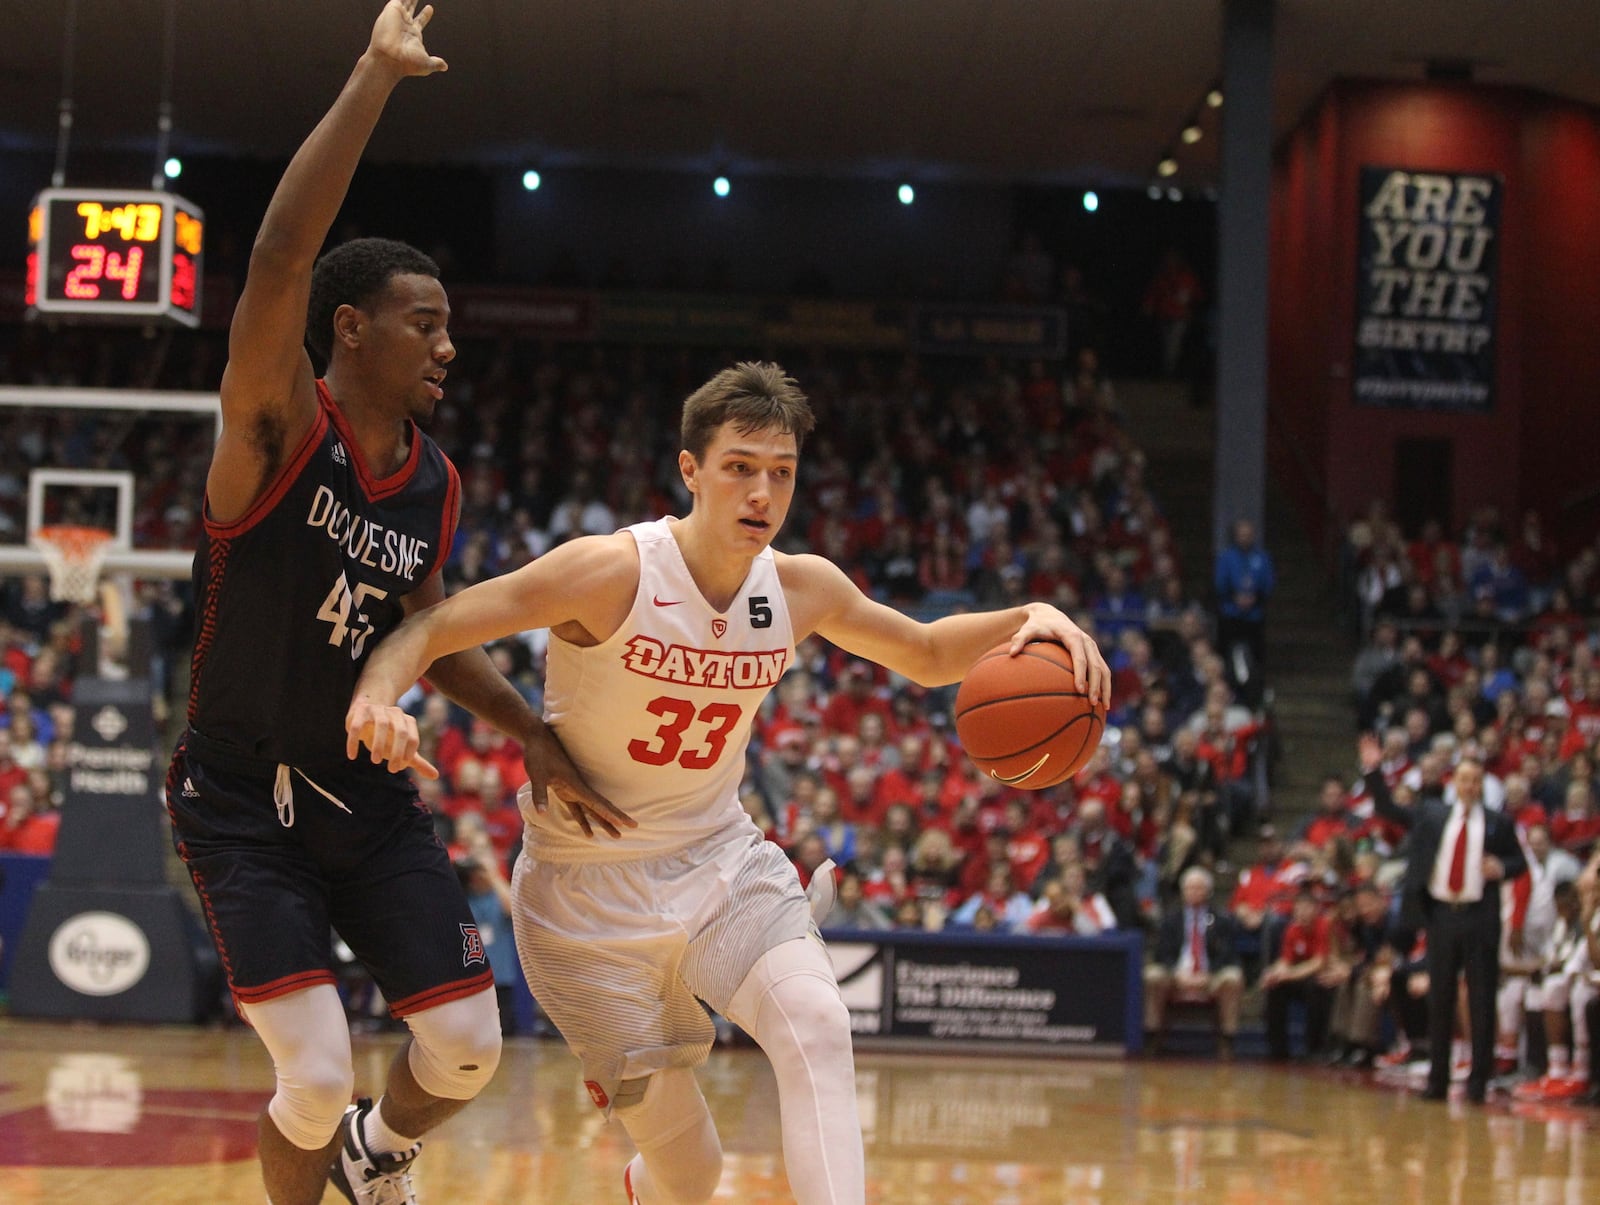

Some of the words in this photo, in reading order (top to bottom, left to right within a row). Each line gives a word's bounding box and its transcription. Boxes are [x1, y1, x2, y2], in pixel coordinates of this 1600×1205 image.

[77, 202, 162, 241] 7:43
[1366, 172, 1493, 224] ARE
[64, 244, 143, 300] 24
[1371, 221, 1492, 272] YOU
[1370, 270, 1489, 321] THE
[748, 596, 773, 629] 5
[621, 634, 788, 690] DAYTON
[627, 695, 743, 770] 33
[70, 768, 148, 794] Health
[896, 961, 1019, 988] Experience
[897, 984, 937, 1006] The
[940, 986, 1056, 1011] Difference
